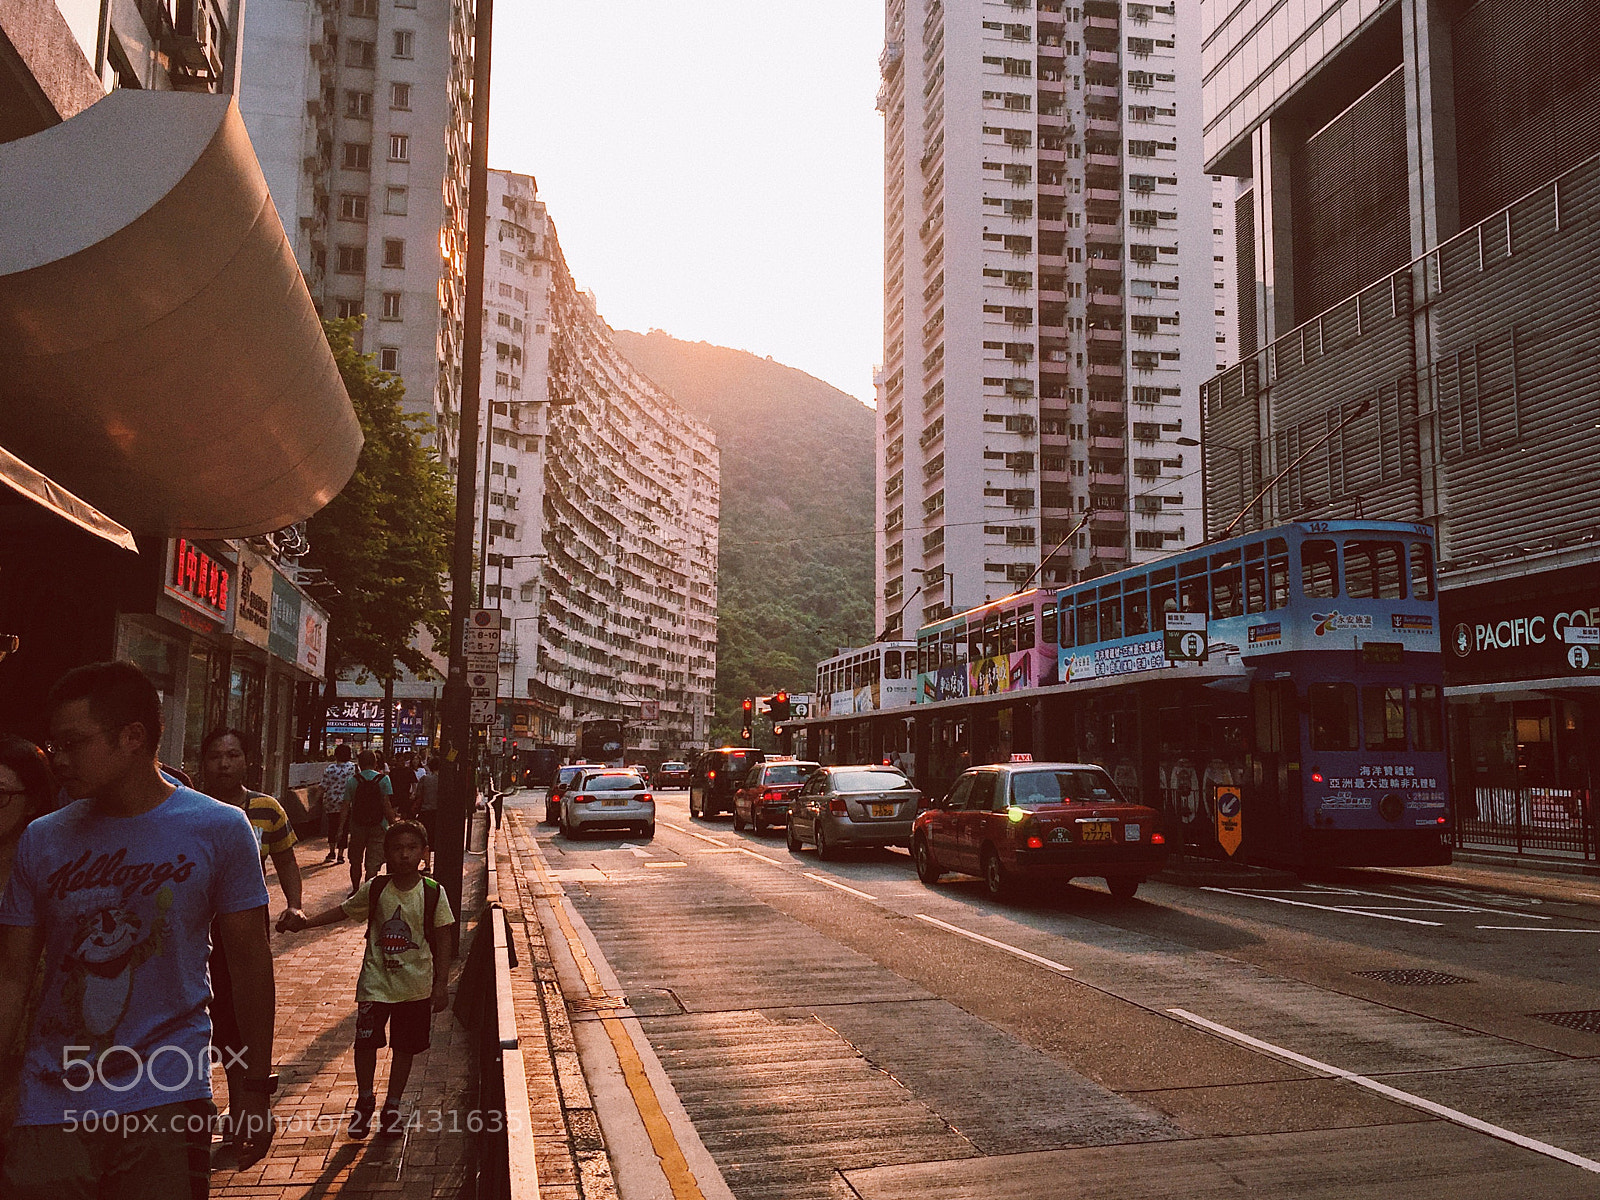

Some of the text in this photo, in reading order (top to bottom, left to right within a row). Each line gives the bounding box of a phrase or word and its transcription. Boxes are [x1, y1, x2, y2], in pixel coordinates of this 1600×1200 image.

[1309, 523, 1329, 533] 142
[1413, 525, 1428, 536] 142
[477, 631, 498, 640] 8-10
[1475, 615, 1546, 652] PACIFIC
[483, 701, 489, 710] 7
[482, 714, 494, 723] 12
[1439, 833, 1452, 846] 142
[47, 848, 196, 900] Kellogg's
